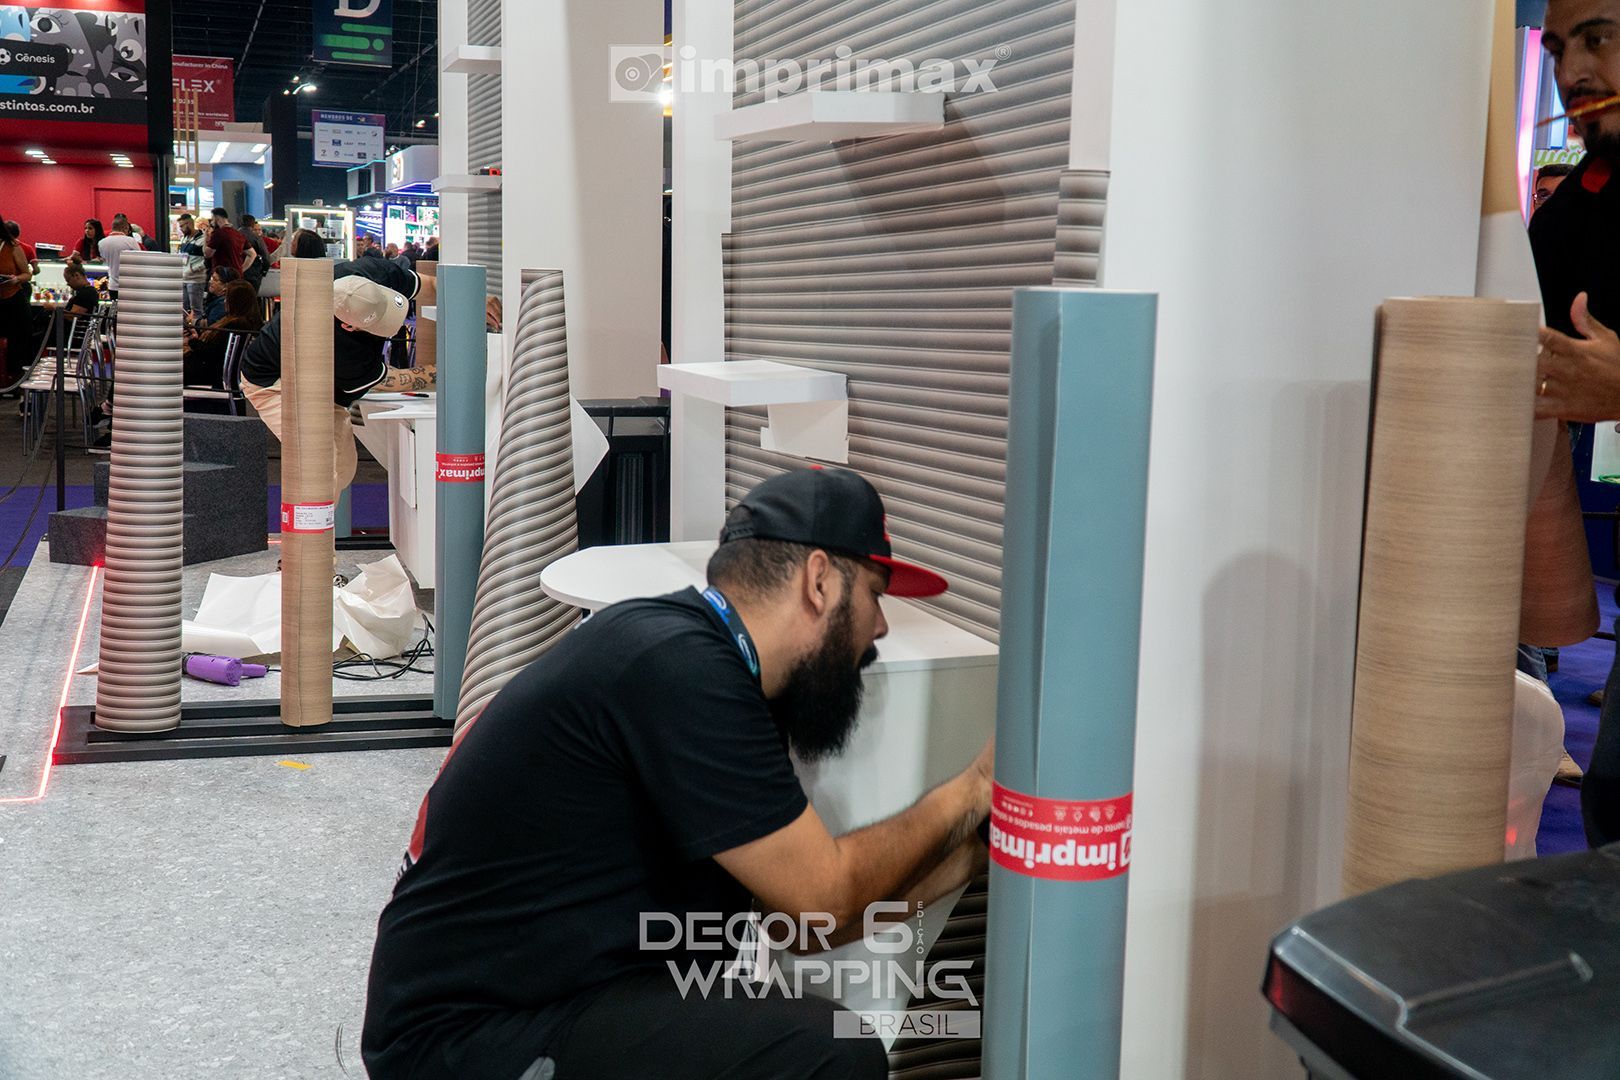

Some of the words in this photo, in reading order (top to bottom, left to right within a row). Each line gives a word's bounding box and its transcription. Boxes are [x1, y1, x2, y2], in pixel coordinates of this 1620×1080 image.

[15, 53, 56, 64] Gênesis
[0, 99, 95, 114] stintas.com.br
[1014, 818, 1053, 832] pesados
[1053, 824, 1090, 836] metais
[1090, 825, 1104, 836] de
